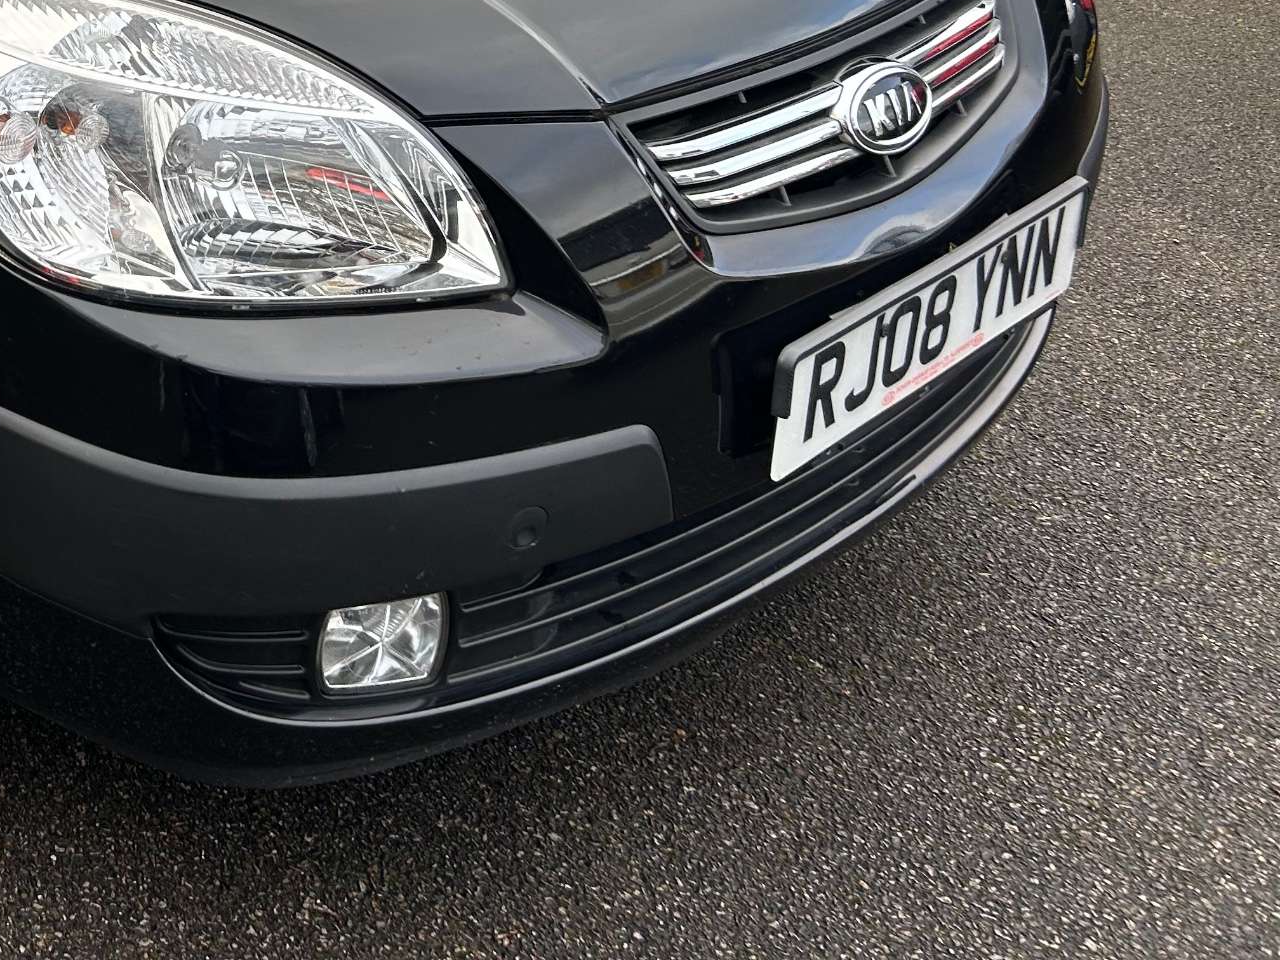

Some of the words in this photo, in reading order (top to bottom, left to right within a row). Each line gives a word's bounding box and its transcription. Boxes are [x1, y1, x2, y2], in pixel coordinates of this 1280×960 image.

[863, 80, 922, 137] KIA
[803, 274, 958, 443] RJ08
[973, 205, 1067, 333] YNN
